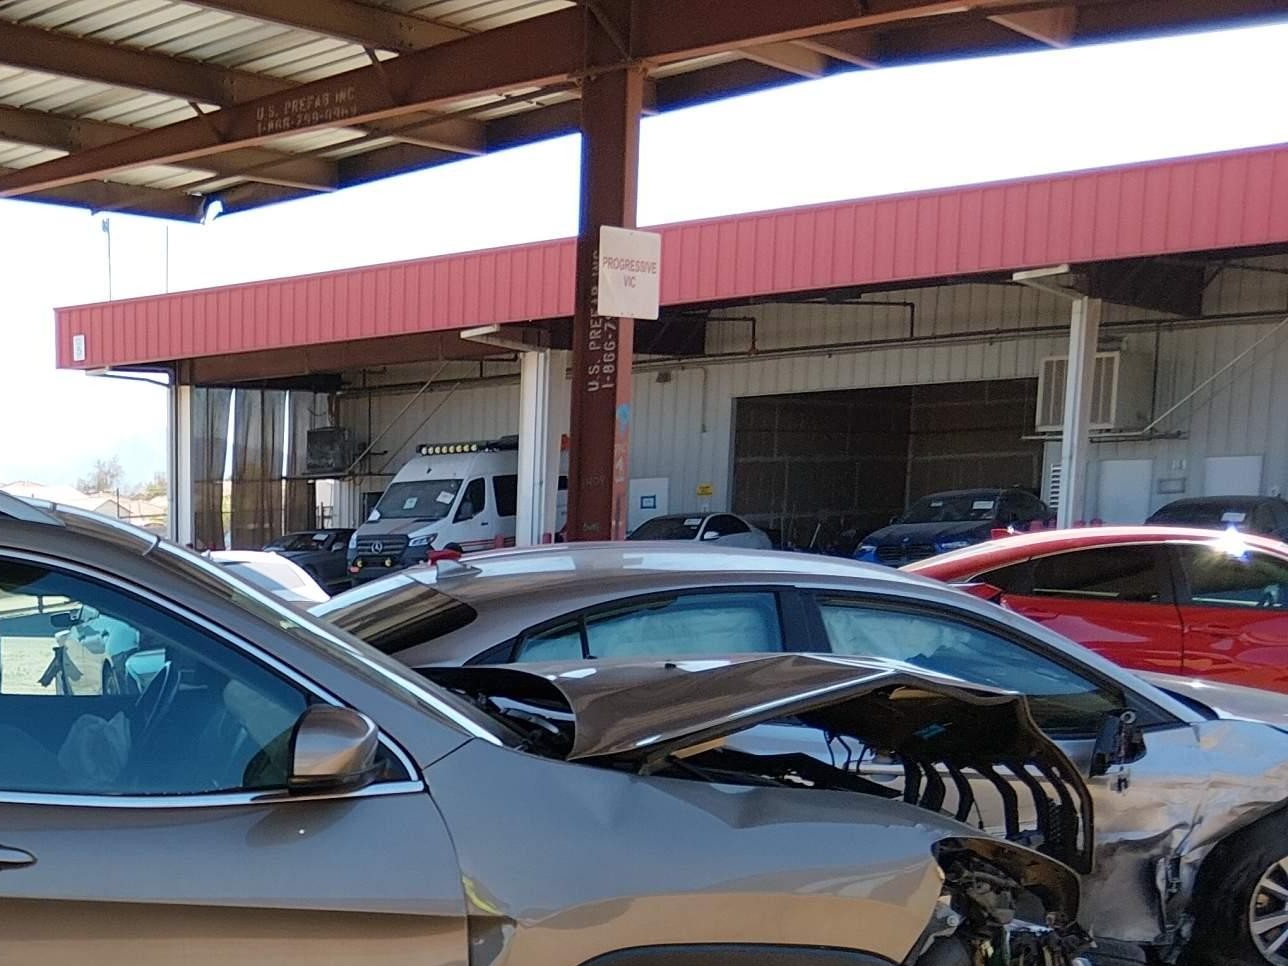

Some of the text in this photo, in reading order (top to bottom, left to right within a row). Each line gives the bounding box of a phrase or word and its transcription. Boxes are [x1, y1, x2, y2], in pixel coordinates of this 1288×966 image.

[284, 92, 329, 115] PREFAB
[602, 257, 657, 275] PROGRESSIVE
[623, 276, 636, 288] VIC
[588, 358, 601, 392] U.S.
